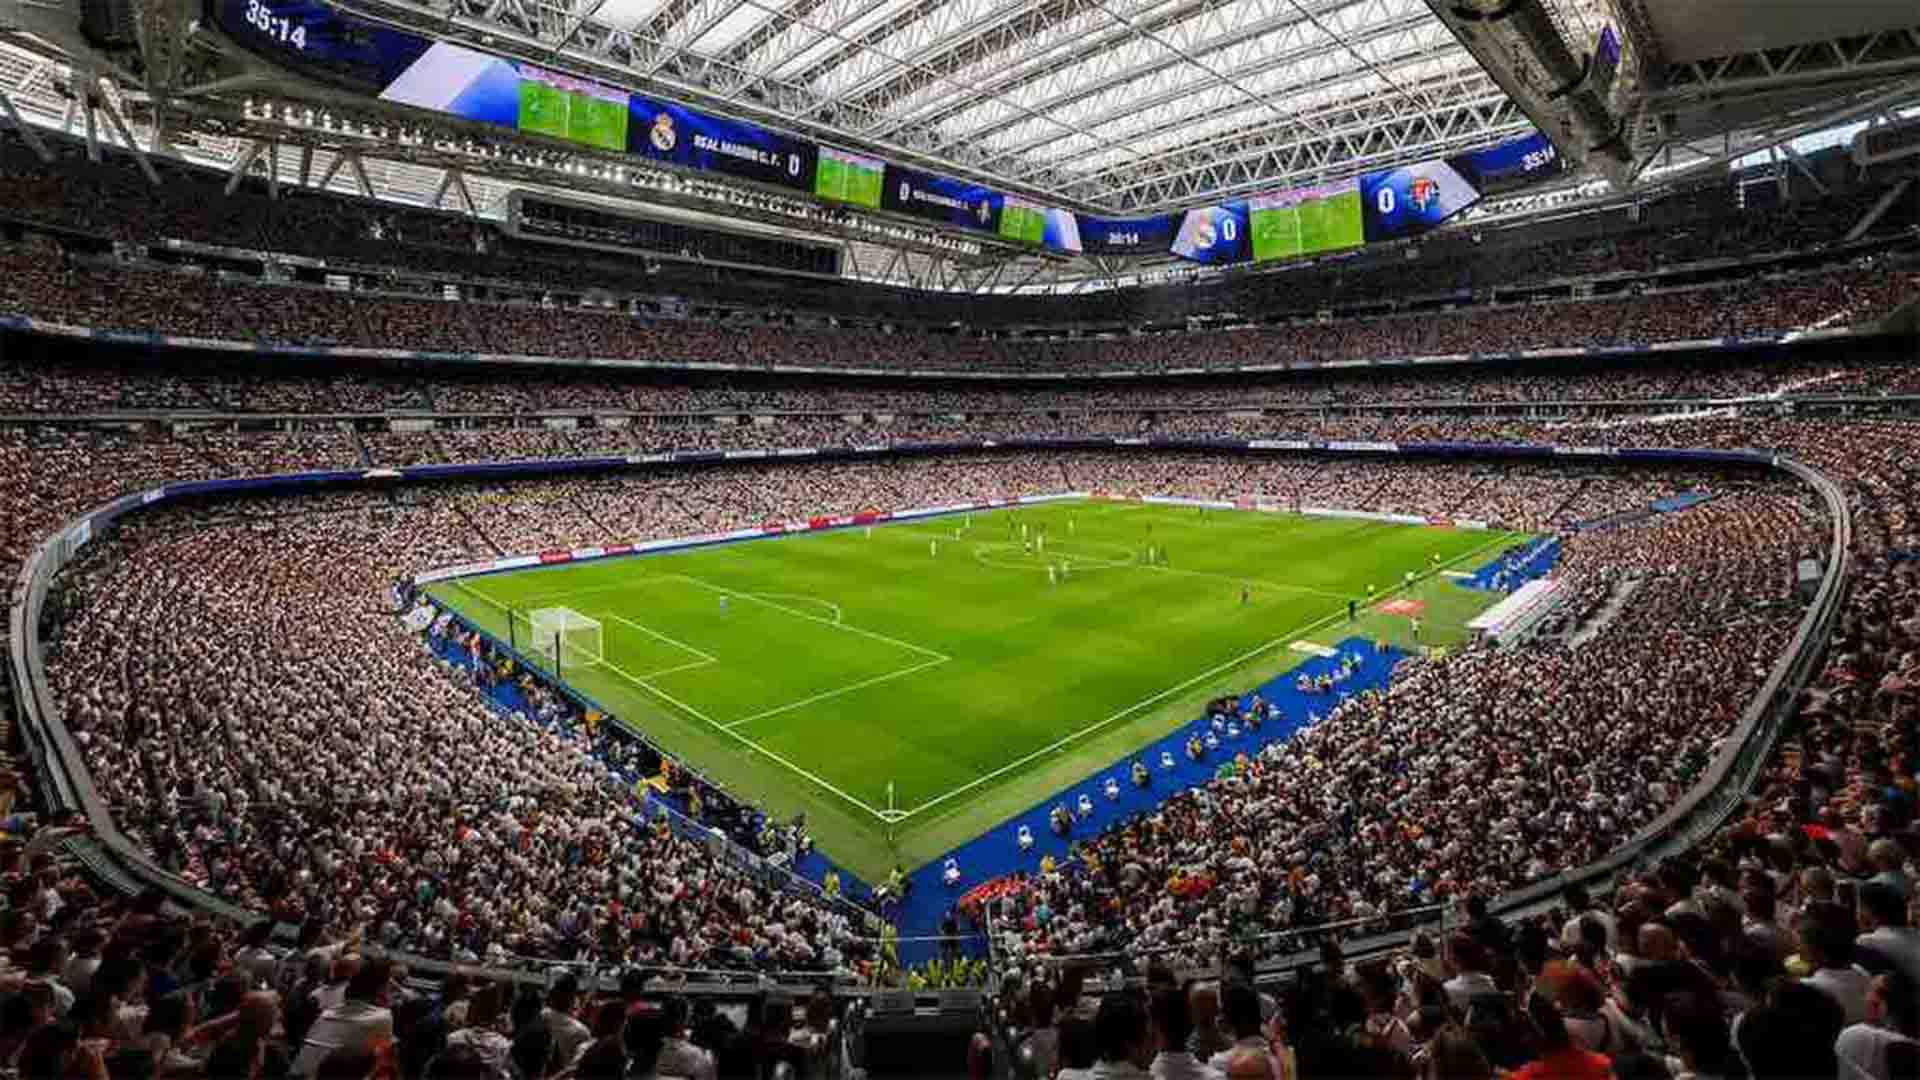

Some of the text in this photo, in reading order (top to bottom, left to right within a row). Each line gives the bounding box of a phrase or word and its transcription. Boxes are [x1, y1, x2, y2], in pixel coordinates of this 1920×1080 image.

[245, 0, 306, 49] 35:14
[788, 154, 800, 176] 0
[1376, 187, 1395, 214] 0
[1223, 218, 1236, 241] 0
